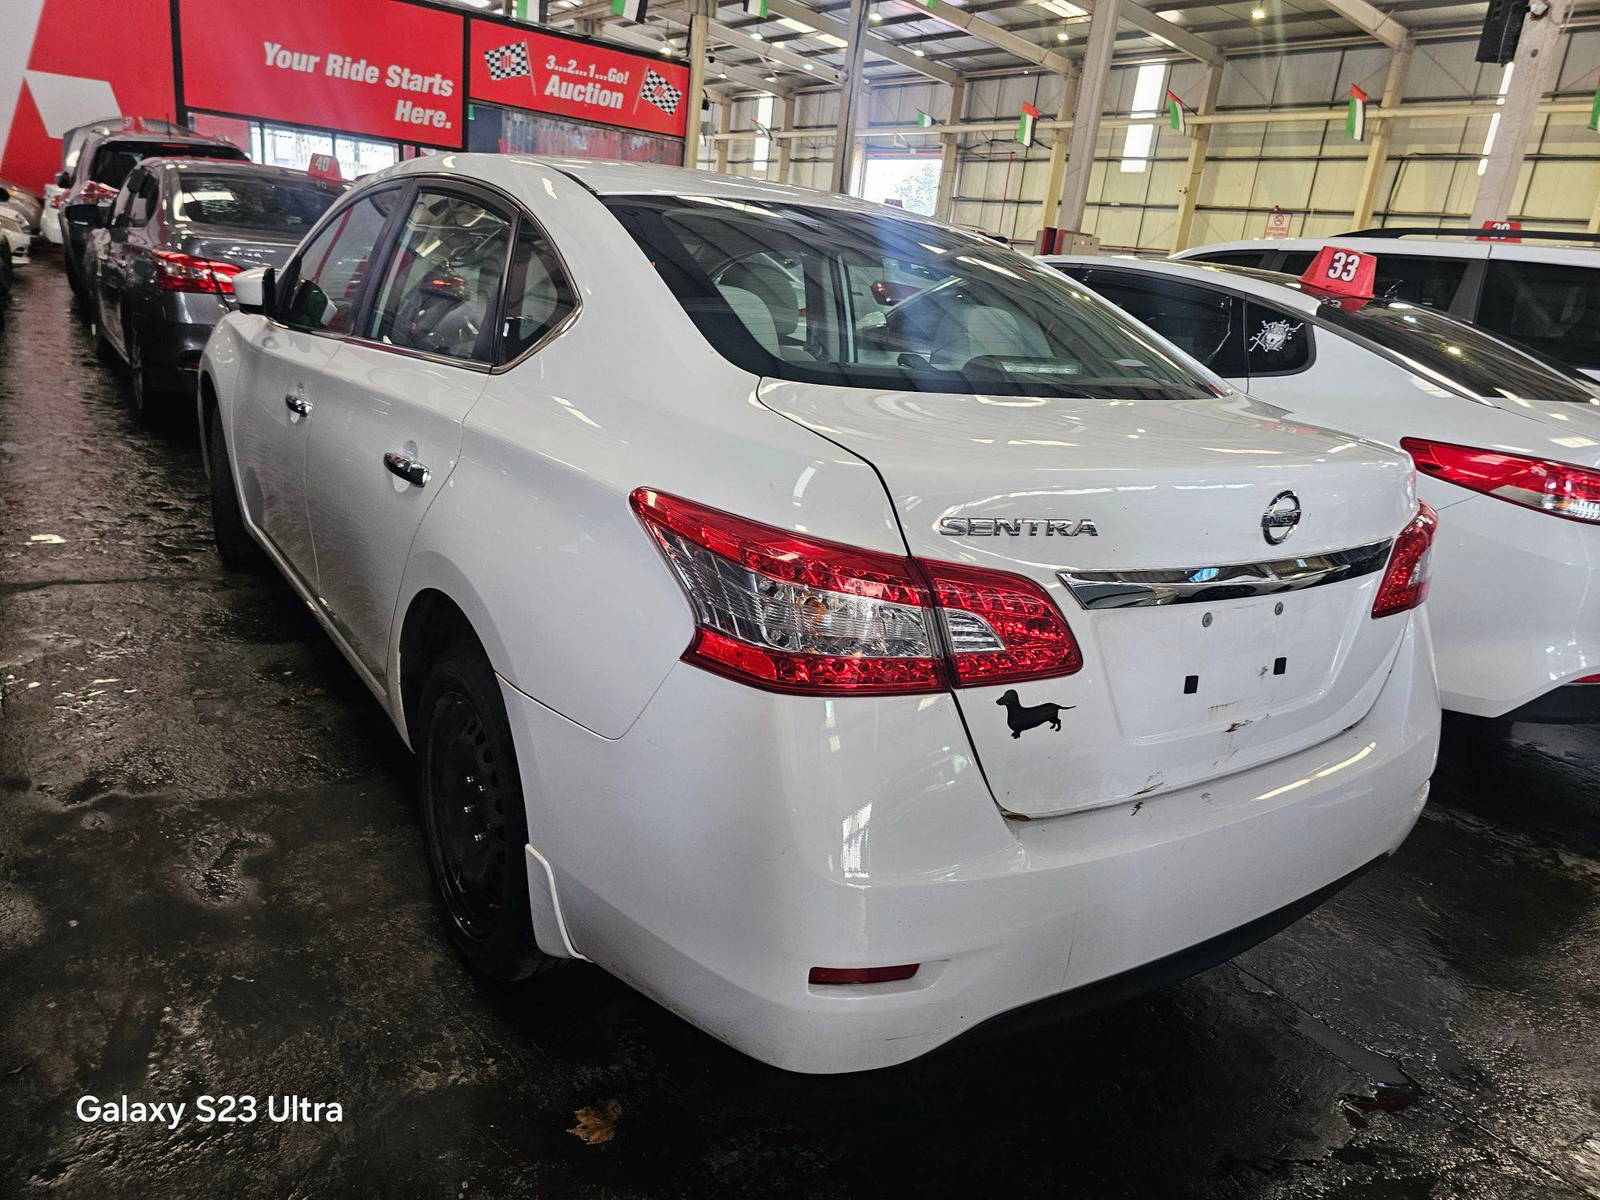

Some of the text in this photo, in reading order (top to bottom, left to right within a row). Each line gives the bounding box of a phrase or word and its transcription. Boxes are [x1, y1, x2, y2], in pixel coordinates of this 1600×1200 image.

[264, 42, 454, 97] Your Ride Starts
[545, 54, 630, 85] 3...2...1...Go!
[544, 74, 624, 110] Auction
[394, 99, 452, 129] Here.
[315, 155, 330, 172] 40
[1327, 251, 1361, 282] 33
[939, 517, 1098, 537] SENTRA
